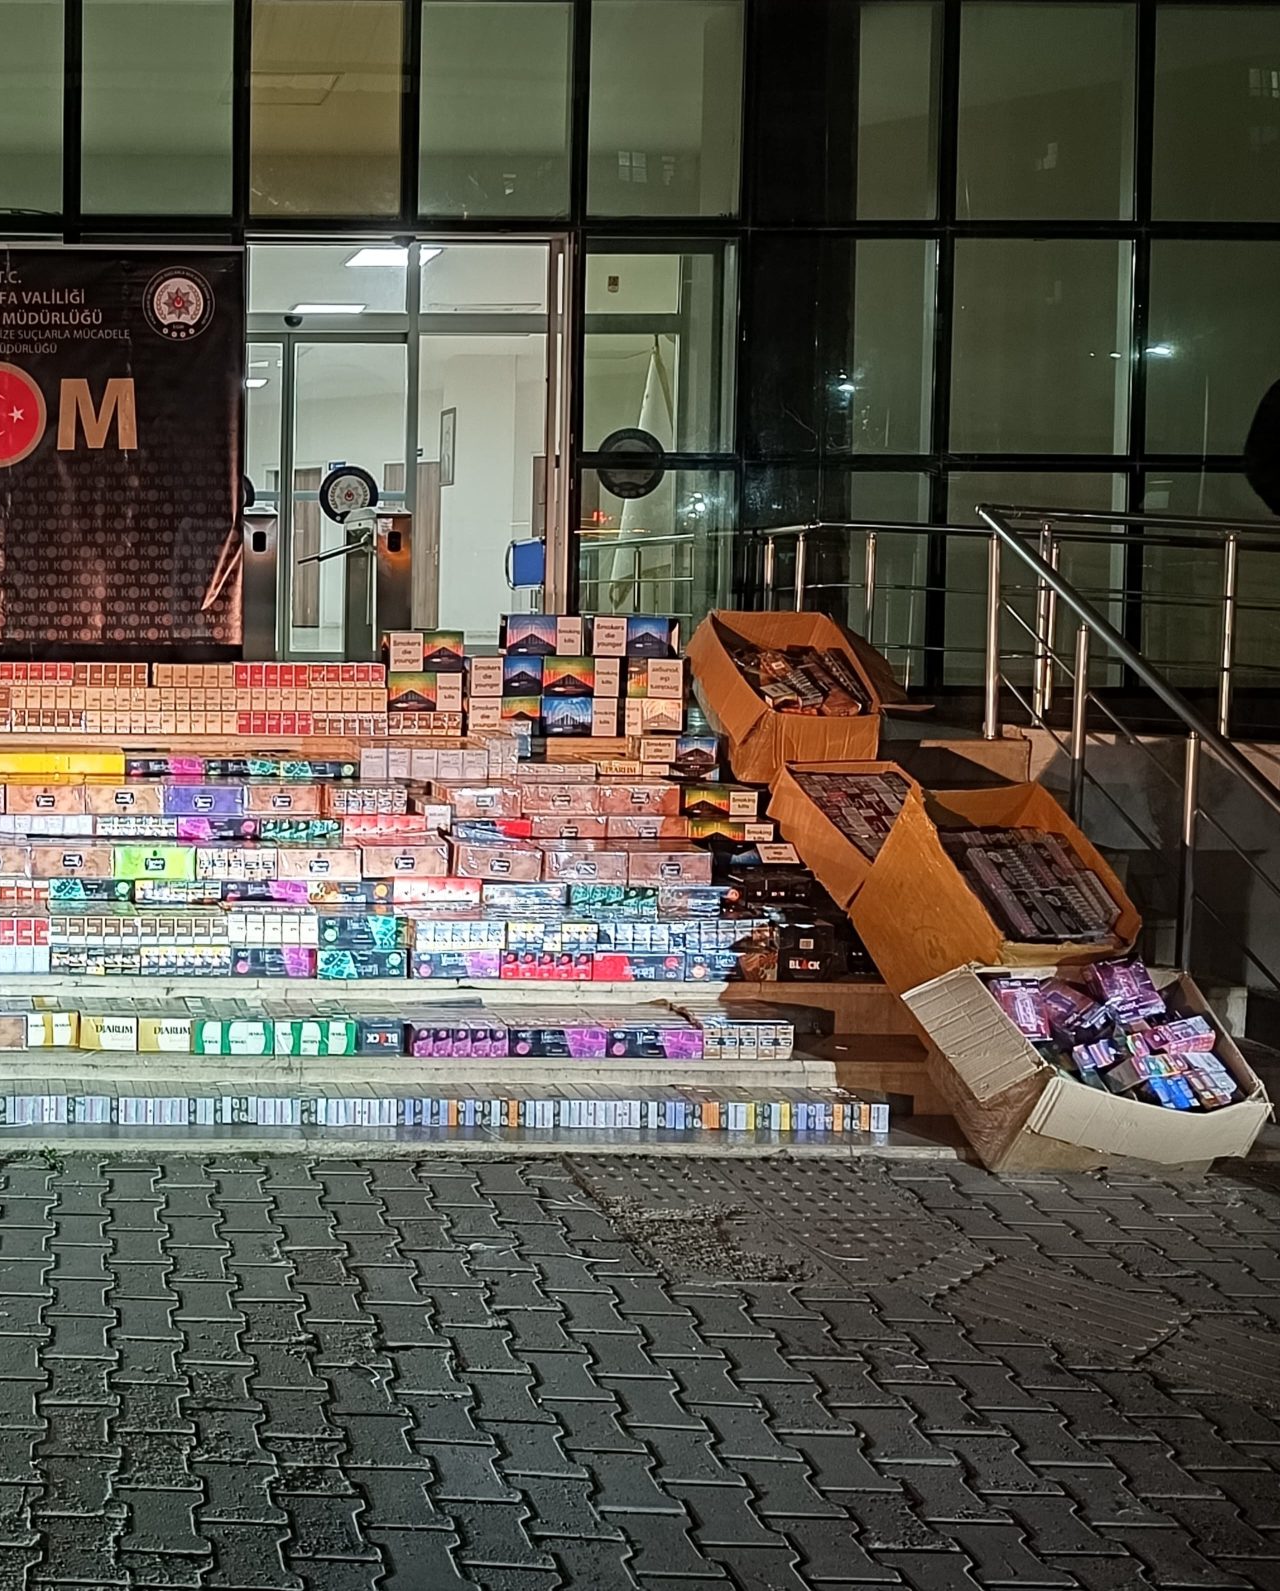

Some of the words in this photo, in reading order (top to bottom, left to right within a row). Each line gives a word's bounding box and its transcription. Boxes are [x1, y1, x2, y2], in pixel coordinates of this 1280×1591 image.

[22, 288, 85, 304] VALİLİĞİ
[2, 309, 102, 325] MÜDÜRLÜĞÜ
[17, 329, 71, 341] SUÇLARLA
[73, 328, 130, 340] MÜCADELE
[95, 1024, 133, 1034] DJARUM
[153, 1026, 191, 1035] DJARUM
